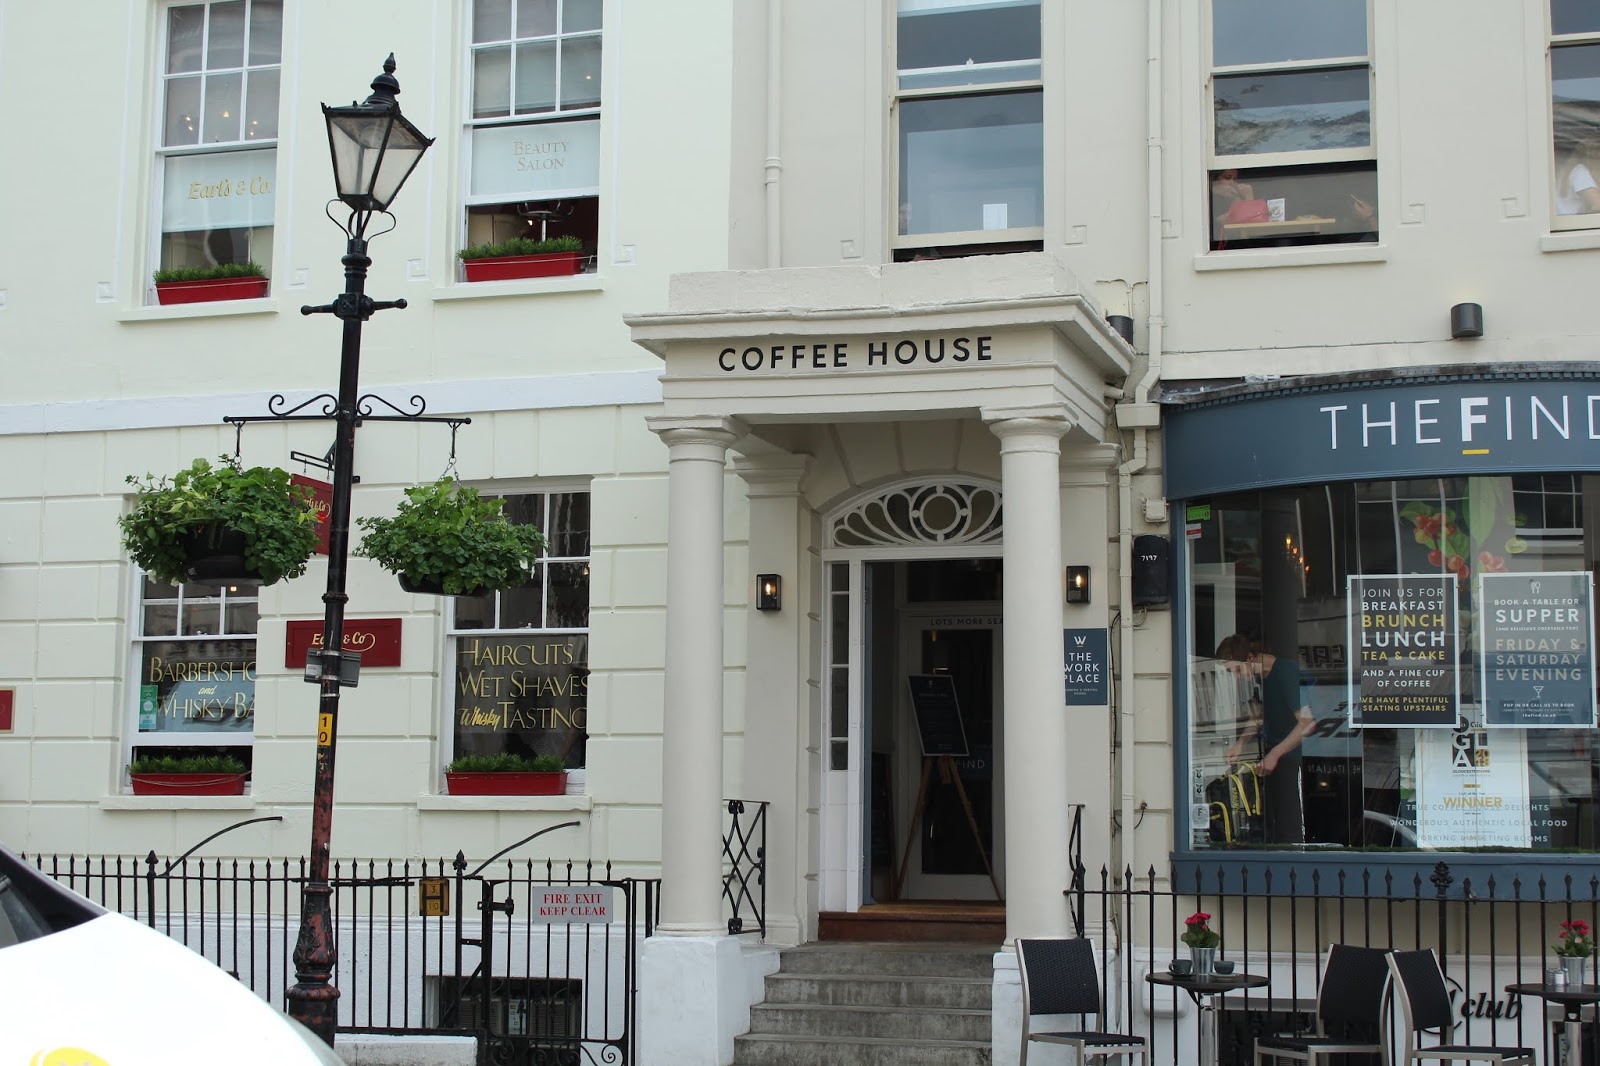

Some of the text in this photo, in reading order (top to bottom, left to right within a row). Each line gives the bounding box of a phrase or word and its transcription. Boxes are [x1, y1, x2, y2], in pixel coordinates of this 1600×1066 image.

[513, 141, 568, 156] BEAUTY
[517, 157, 565, 172] SALON
[718, 336, 992, 372] COFFEE HOUSE
[1362, 588, 1444, 598] JOIN US FOR
[1362, 600, 1444, 611] BREAKFAST
[1362, 614, 1445, 628] BRUNCH
[1495, 608, 1580, 623] SUPPER
[930, 618, 953, 626] LOTS
[343, 634, 350, 644] &
[1361, 630, 1445, 647] LUNCH
[1495, 638, 1580, 650] FRIDAY &
[1069, 652, 1092, 661] THE
[1362, 651, 1445, 660] TEA & CAKE
[1496, 654, 1580, 665] SATURDAY
[150, 656, 256, 682] BARBERSHO
[1064, 663, 1100, 672] WORK
[1495, 668, 1582, 680] EVENING
[198, 685, 217, 695] and
[234, 692, 255, 718] BA
[1443, 797, 1503, 807] WINNER
[543, 893, 602, 904] FIRE EXIT
[540, 906, 606, 916] KEEP CLEAR
[1461, 993, 1522, 1019] club
